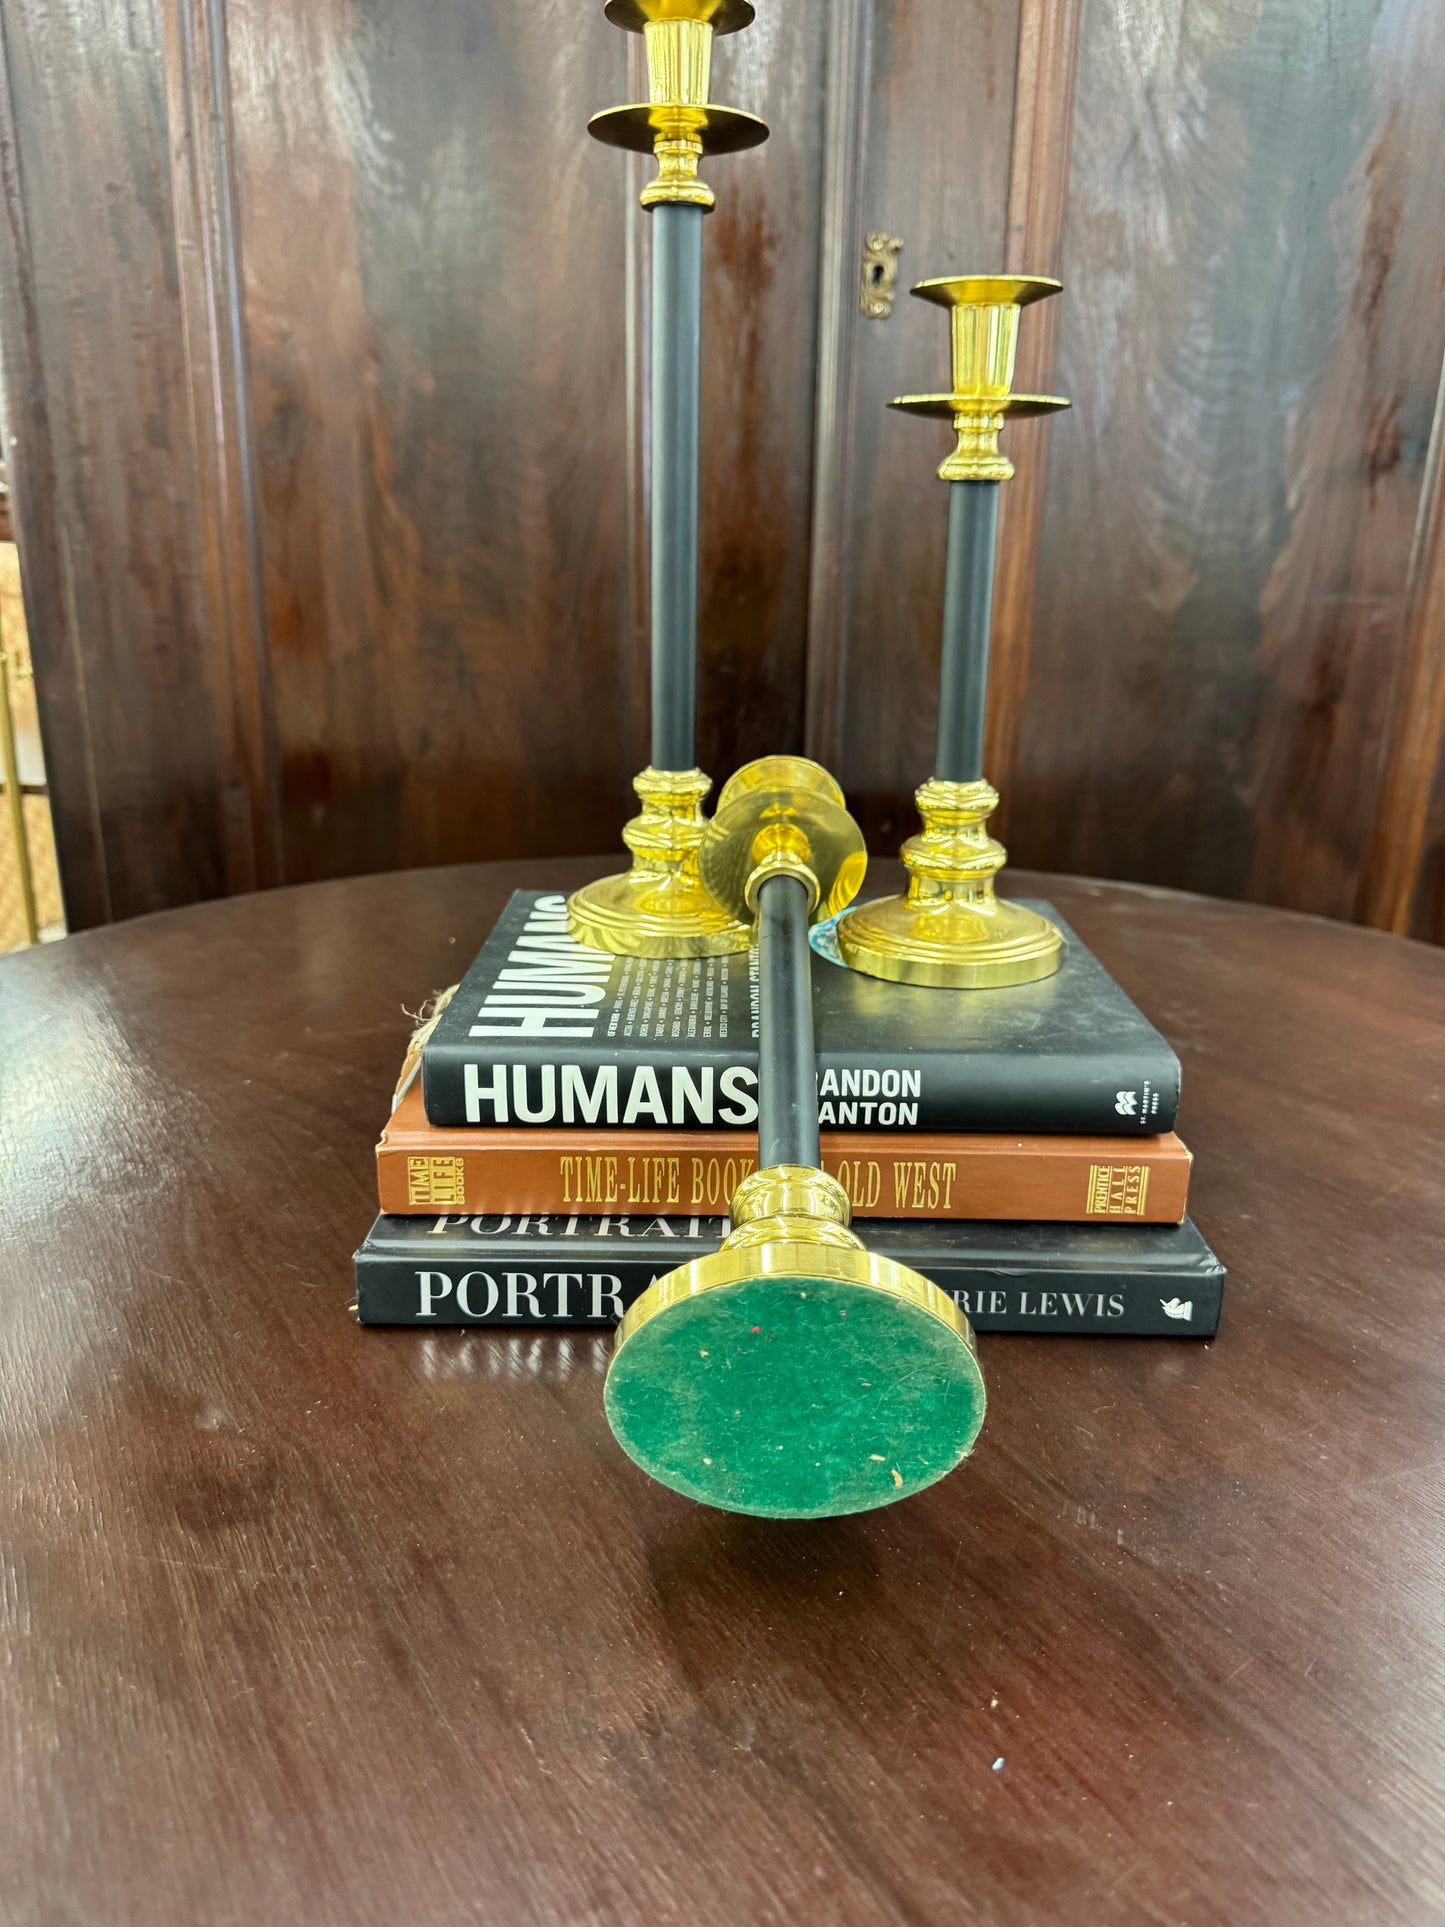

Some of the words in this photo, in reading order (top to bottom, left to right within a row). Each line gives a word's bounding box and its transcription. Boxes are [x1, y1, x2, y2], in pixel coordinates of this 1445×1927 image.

[464, 1063, 760, 1126] HUMANS
[816, 1068, 921, 1098] ANDON
[818, 1101, 919, 1126] ANTON
[409, 1158, 430, 1204] TIME
[433, 1159, 455, 1202] LIFE
[456, 1157, 465, 1204] BOOKS
[560, 1156, 680, 1203] TIME-LIFE
[837, 1160, 881, 1208] OLD
[893, 1161, 957, 1210] WEST
[1093, 1165, 1110, 1214] PRENTICE
[1108, 1165, 1126, 1214] HALL
[1123, 1165, 1141, 1215] PRESS
[414, 1271, 658, 1318] PORTR
[944, 1289, 1008, 1315] RIE
[1018, 1291, 1125, 1318] LEWIS
